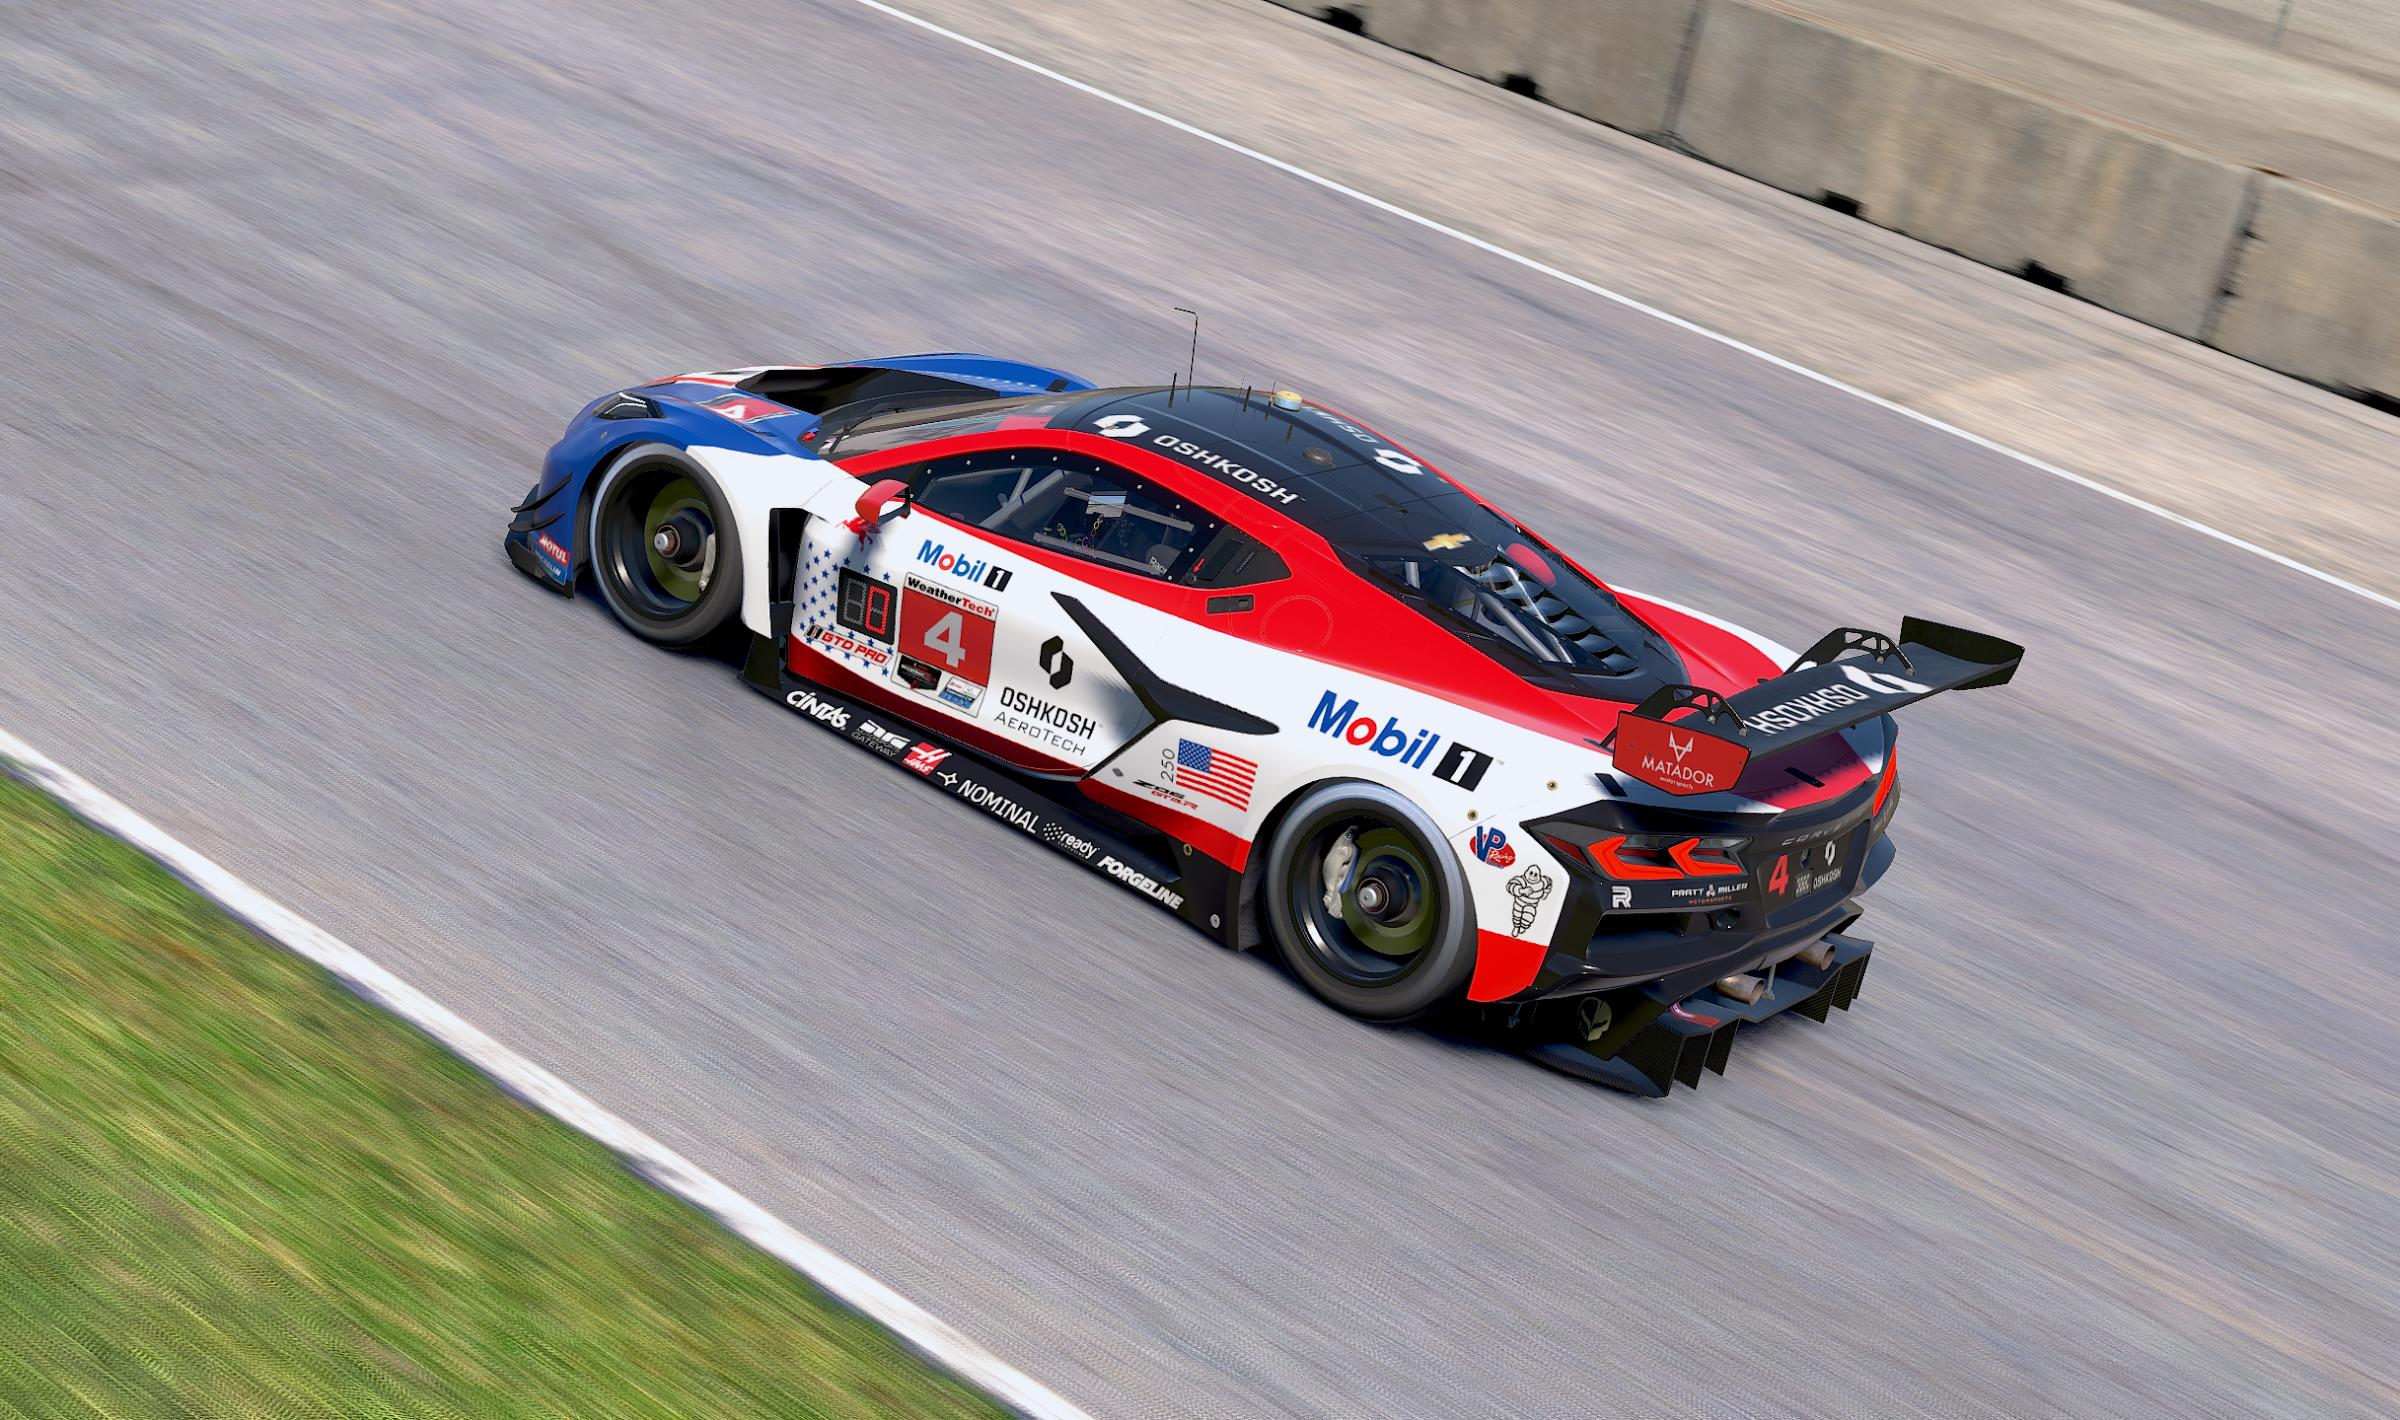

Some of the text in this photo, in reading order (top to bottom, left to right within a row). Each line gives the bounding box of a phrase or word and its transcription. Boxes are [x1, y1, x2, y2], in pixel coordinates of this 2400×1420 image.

[1153, 435, 1299, 505] OSHKOSH
[539, 534, 567, 564] MOTUL
[916, 539, 987, 582] Mobil
[908, 577, 993, 617] WeatherTech
[821, 631, 888, 664] GTD PRO
[923, 610, 967, 668] 4
[1000, 686, 1097, 740] OSHKOSH
[1743, 683, 1871, 736] OSHKOSH
[851, 732, 898, 758] GATEWAY
[994, 711, 1086, 756] AEROTECH
[1307, 689, 1478, 785] Mobil 1
[1160, 748, 1175, 783] 250
[1641, 755, 1714, 788] MATADOR
[957, 779, 1040, 834] NOMINAL
[1060, 829, 1098, 859] ready
[1476, 825, 1506, 862] VP
[1097, 855, 1184, 911] FORGELINE
[1671, 882, 1749, 897] PRATT MILLER
[1768, 854, 1789, 896] 4
[1813, 866, 1843, 891] OSHKOSH
